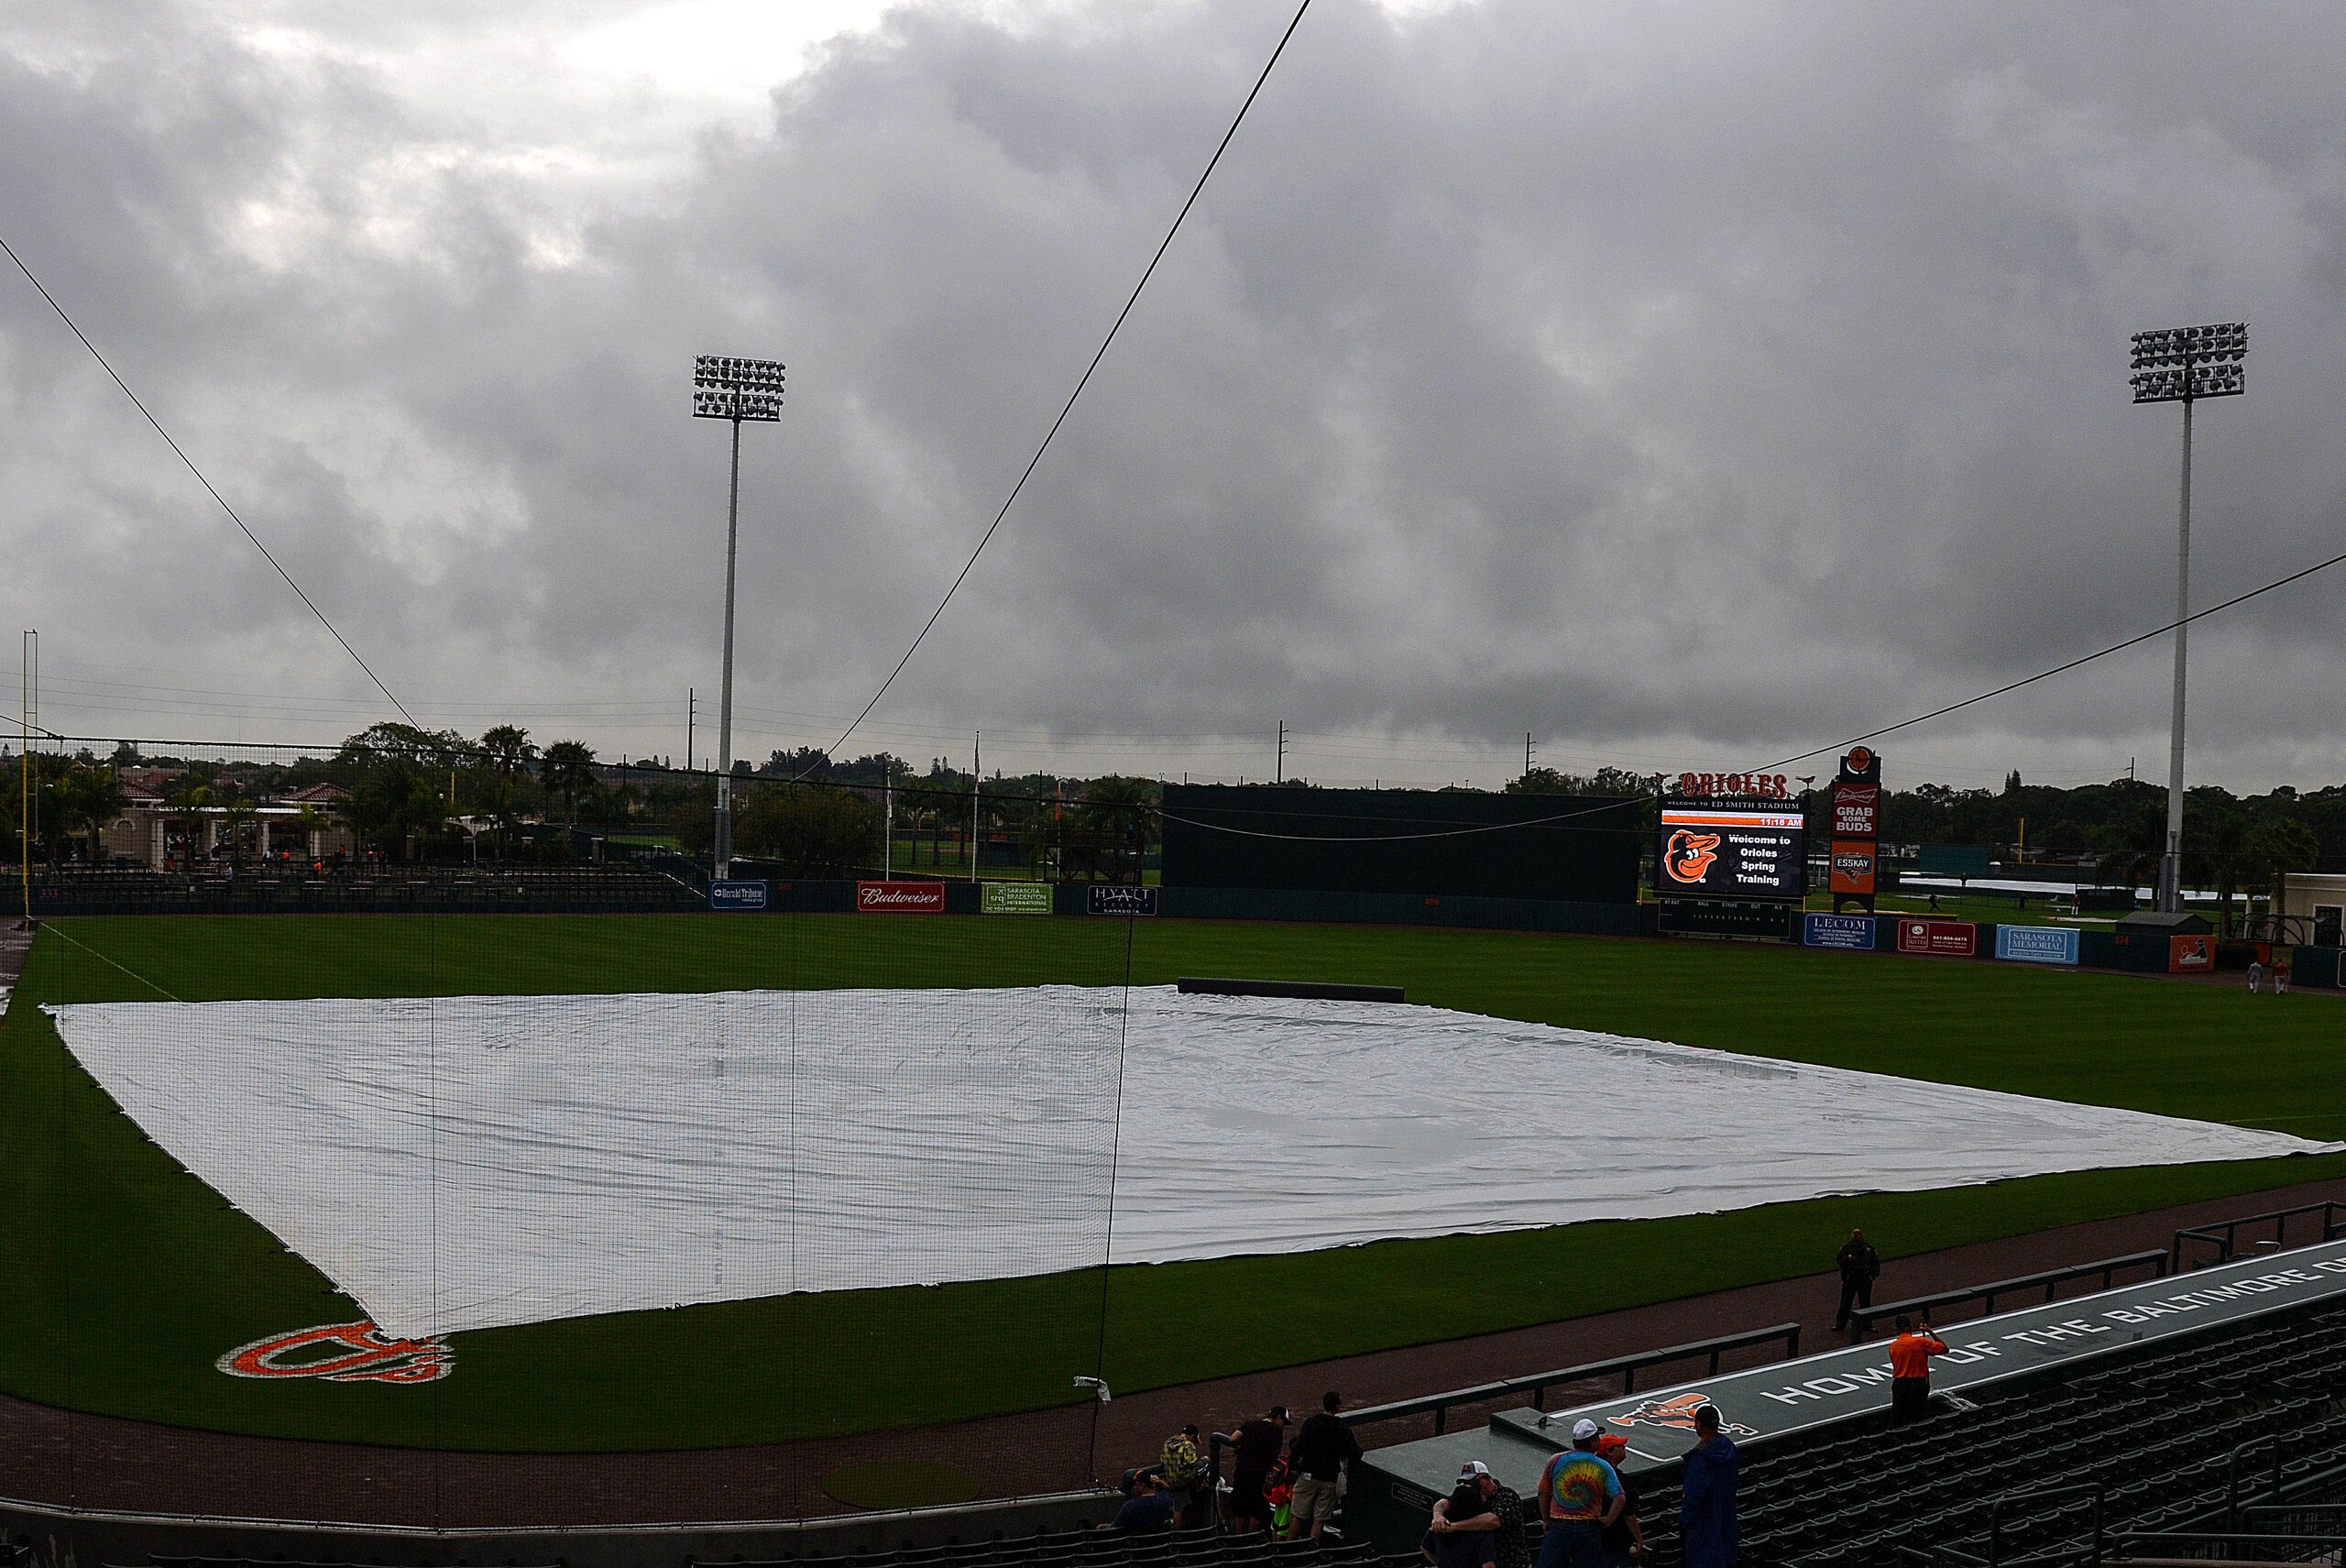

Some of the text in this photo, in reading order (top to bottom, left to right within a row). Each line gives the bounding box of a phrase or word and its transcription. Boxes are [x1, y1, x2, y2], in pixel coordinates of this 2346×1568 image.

[1682, 773, 1788, 799] ORIOLES
[1726, 801, 1754, 809] SMITH
[1758, 802, 1800, 810] STADIUM
[1836, 806, 1873, 817] GRAB
[1760, 818, 1802, 828] 11:18 AM
[1836, 822, 1872, 832] BUDS
[1729, 834, 1792, 845] Welcome to
[1740, 849, 1778, 858] Orioles
[1741, 861, 1776, 872] Spring
[1837, 859, 1869, 868] ESSKAY
[1737, 874, 1780, 886] Training
[861, 888, 940, 905] Budweiser
[990, 895, 1004, 905] srq
[1095, 888, 1149, 902] HYATT
[1814, 917, 1866, 930] LECOM
[2012, 933, 2063, 943] SARASOTA
[2012, 940, 2063, 950] MEMORIAL
[1760, 1363, 1936, 1406] HOM
[1935, 1342, 2001, 1365] OF
[2001, 1319, 2111, 1345] THE
[2101, 1269, 2325, 1324] BALTIMORE
